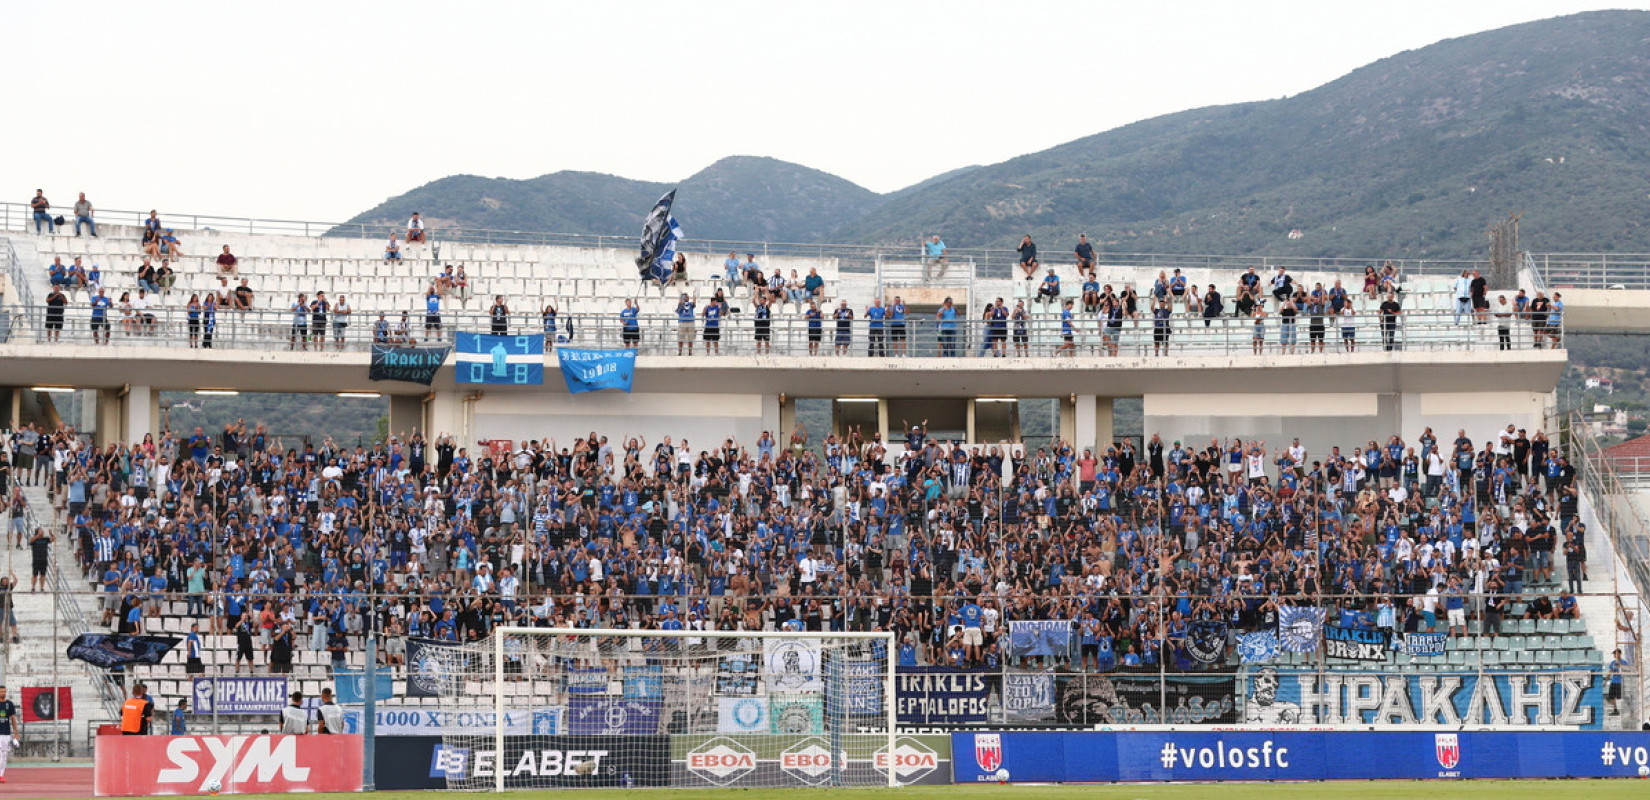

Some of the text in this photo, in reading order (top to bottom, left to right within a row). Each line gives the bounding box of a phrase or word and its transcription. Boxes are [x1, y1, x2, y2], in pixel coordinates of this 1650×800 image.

[514, 335, 530, 354] 9
[514, 363, 529, 384] 8
[216, 680, 286, 702] ΗΡΑΚΛΗΣ
[901, 673, 985, 692] IRAKLIS
[897, 697, 987, 715] EPTALOFOS
[1298, 673, 1594, 726] ΗΡΑΚΛΗΣ
[376, 711, 421, 727] 1000
[156, 734, 311, 792] SYM
[1160, 740, 1289, 768] #volosfc
[1601, 741, 1649, 766] #vo
